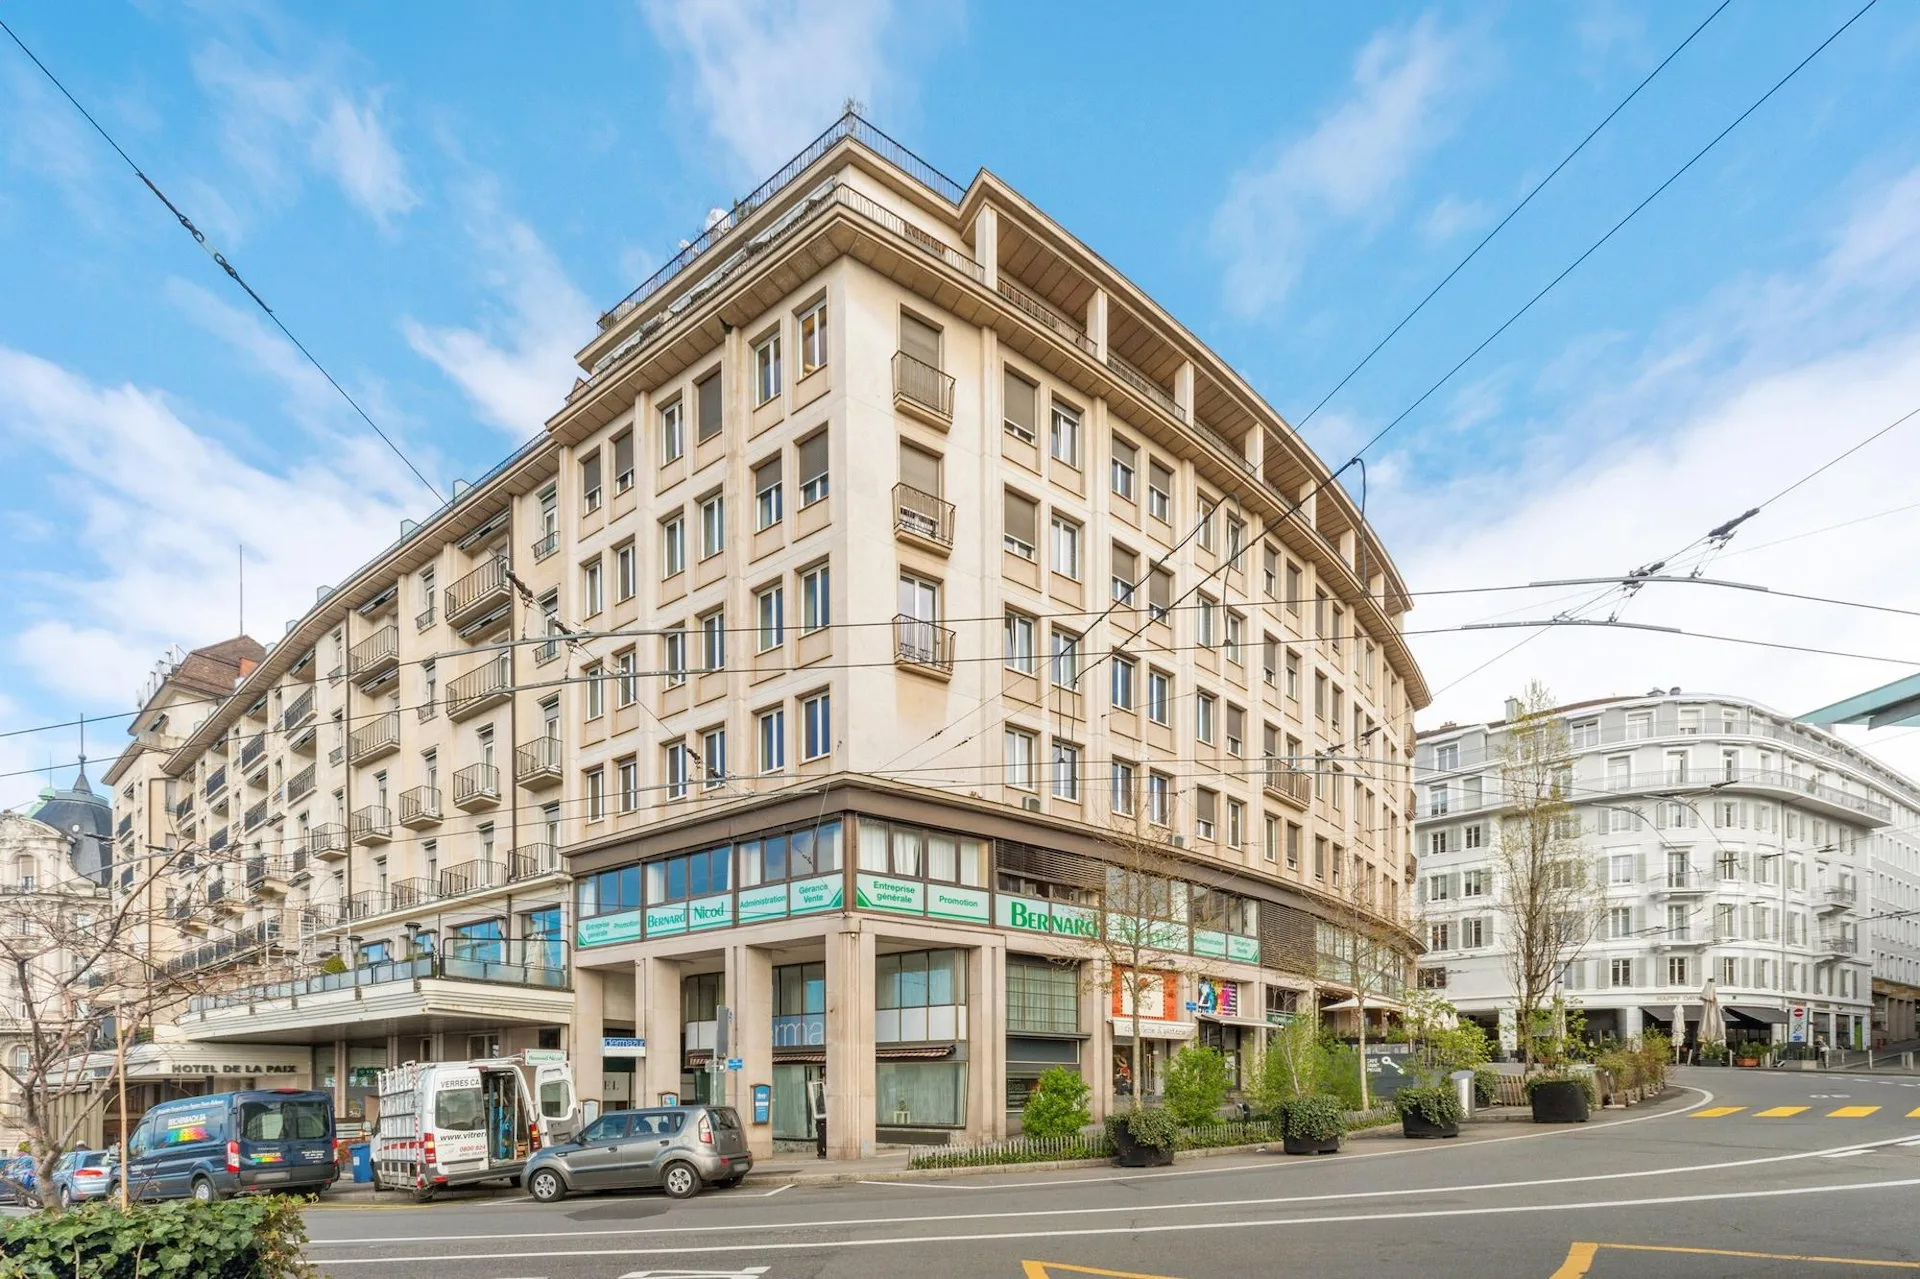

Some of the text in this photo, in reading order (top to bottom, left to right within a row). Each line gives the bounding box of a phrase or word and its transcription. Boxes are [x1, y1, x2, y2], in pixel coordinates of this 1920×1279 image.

[798, 883, 828, 894] Gérance
[873, 880, 915, 894] Entreprise
[740, 894, 786, 909] Administration
[803, 894, 823, 903] Vente
[876, 892, 912, 903] générale
[938, 895, 978, 907] Promotion
[693, 902, 724, 920] Nicod
[171, 1064, 298, 1073] HOTEL DE LA PAIX
[440, 1079, 469, 1088] VERRES
